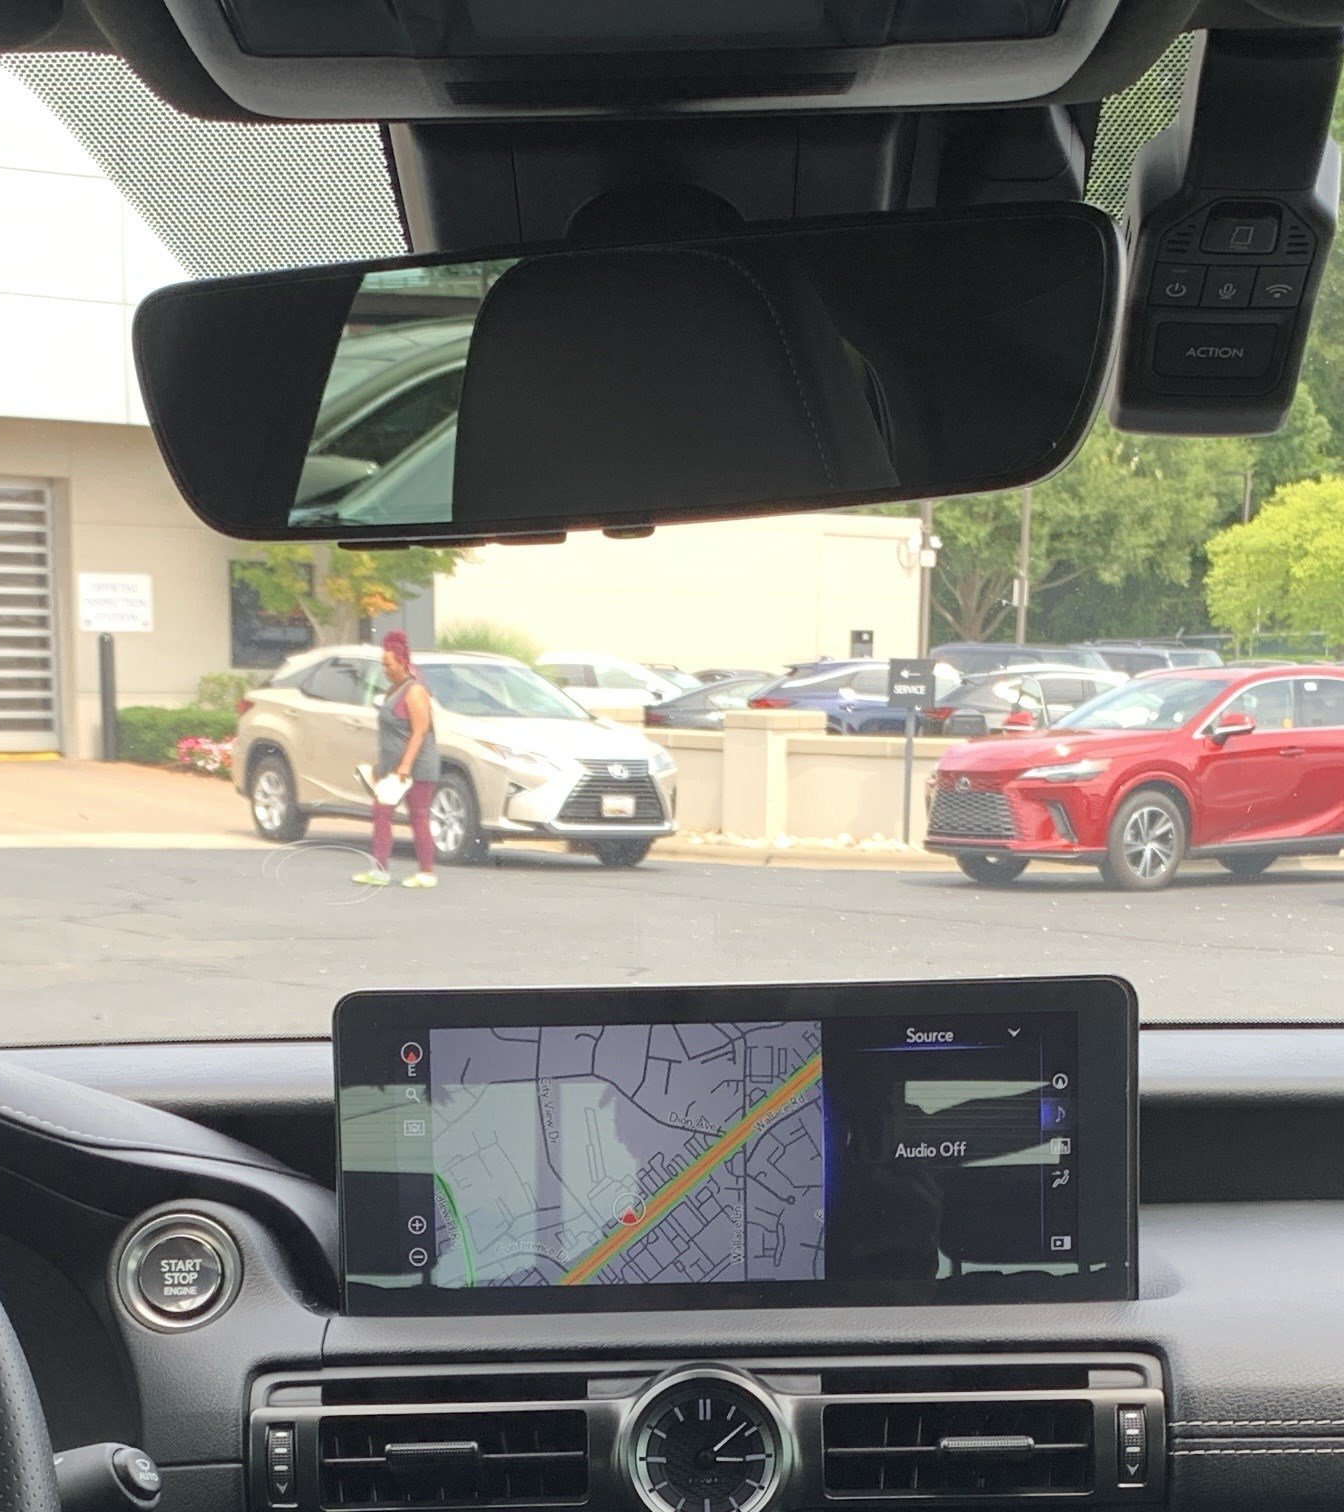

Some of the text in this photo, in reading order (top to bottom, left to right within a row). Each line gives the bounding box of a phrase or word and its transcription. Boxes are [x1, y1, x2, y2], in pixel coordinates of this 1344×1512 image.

[1186, 347, 1244, 358] ACTION
[893, 684, 926, 695] SERVICE
[906, 1028, 954, 1043] Source
[408, 1065, 417, 1077] E
[540, 1077, 551, 1099] City
[544, 1099, 558, 1130] View
[669, 1111, 717, 1131] Dion Ave
[895, 1141, 967, 1158] Audio Off
[161, 1259, 202, 1272] START
[164, 1273, 198, 1285] STOP
[164, 1286, 197, 1296] ENGINE
[139, 1471, 159, 1482] AUTO
